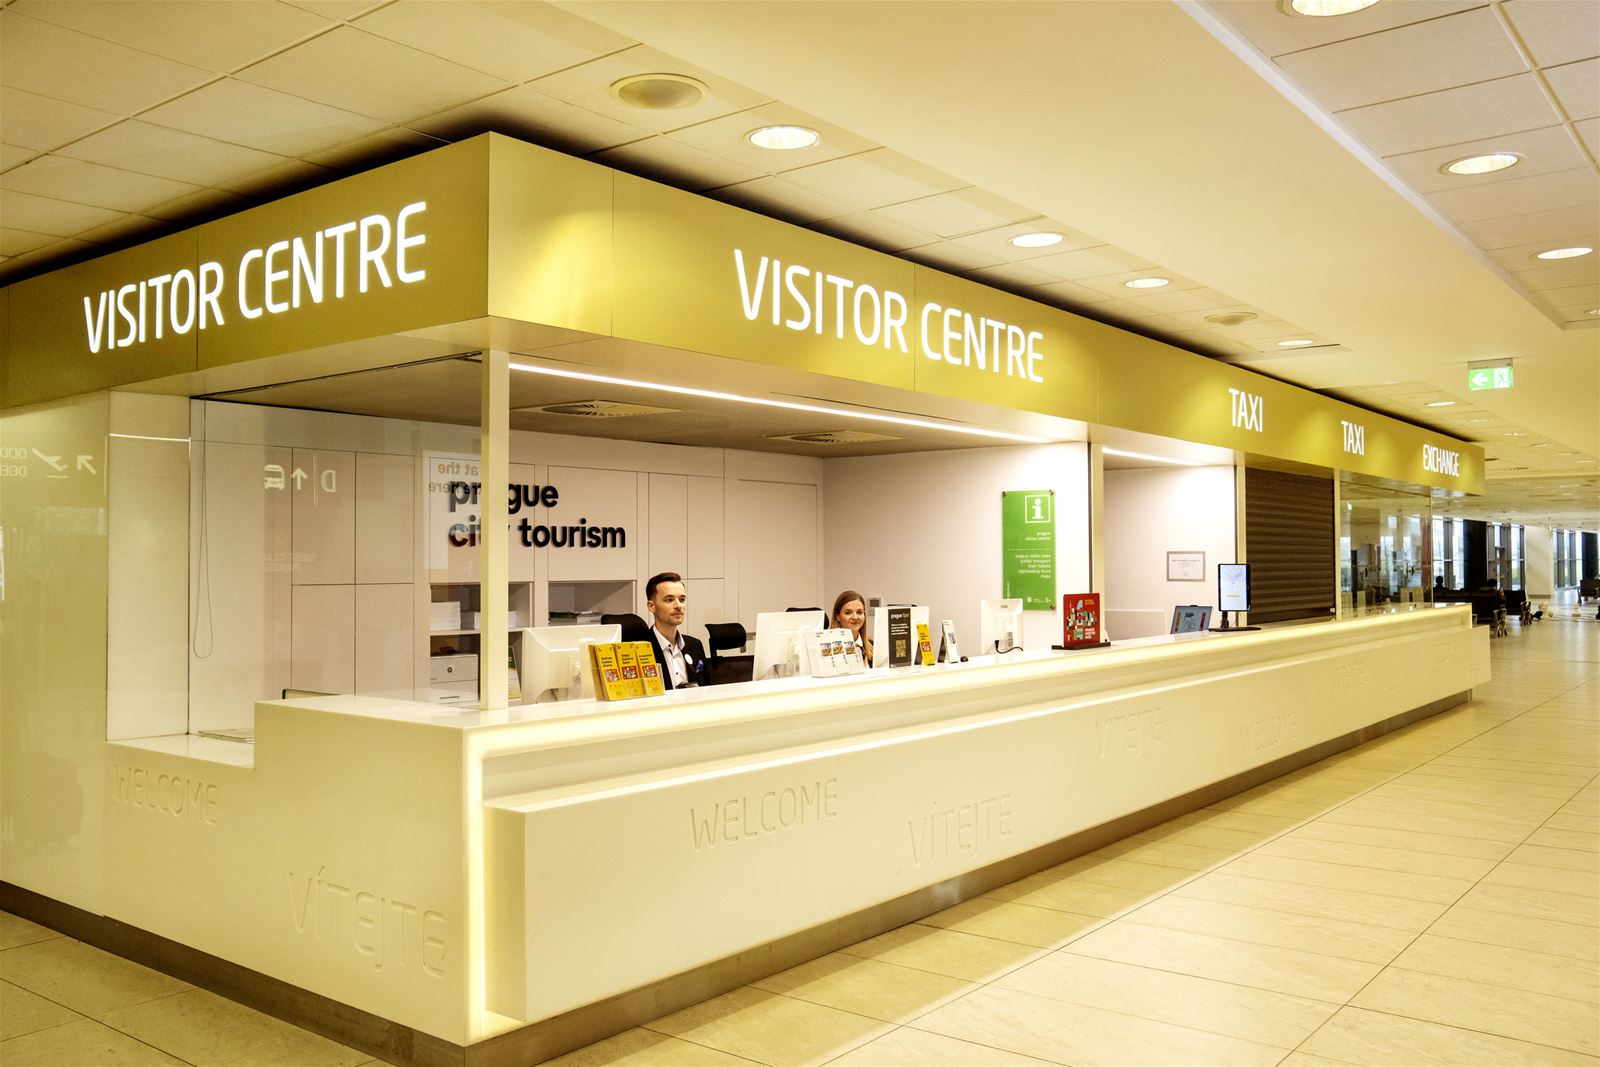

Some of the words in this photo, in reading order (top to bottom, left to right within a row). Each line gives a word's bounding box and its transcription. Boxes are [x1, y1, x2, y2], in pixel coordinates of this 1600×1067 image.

[83, 261, 225, 354] VISITOR
[238, 201, 427, 320] CENTRE
[734, 248, 909, 353] VISITOR
[921, 302, 1044, 383] CENTRE
[1228, 387, 1264, 433] TAXI
[1341, 420, 1365, 456] TAXI
[1422, 443, 1460, 477] EXCHANGE
[449, 481, 559, 515] prgue
[518, 518, 626, 548] tourism
[113, 764, 218, 826] WELCOME
[690, 777, 838, 851] WELCOME
[908, 794, 1012, 868] VÍTEJTE
[289, 865, 446, 978] VÍTEJTE
